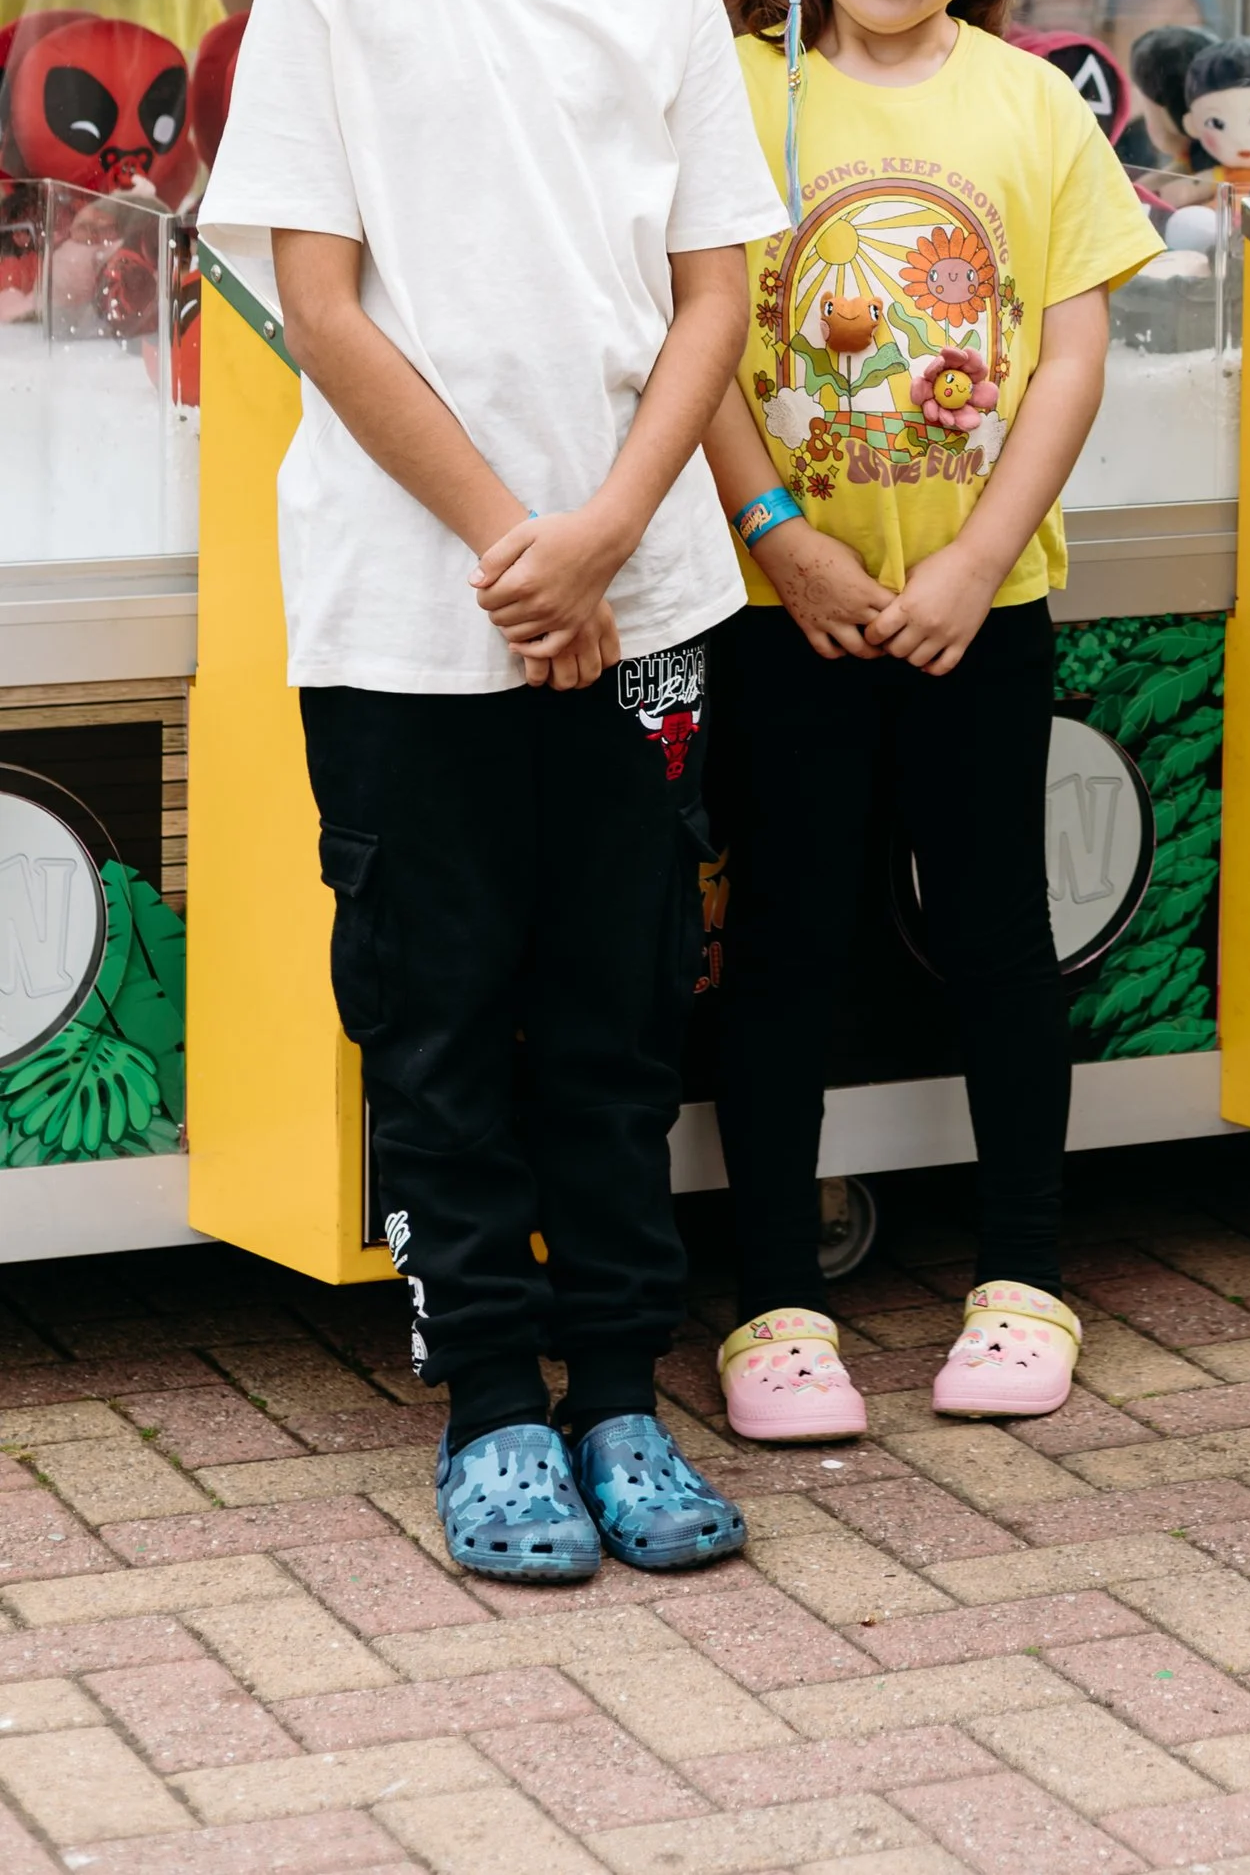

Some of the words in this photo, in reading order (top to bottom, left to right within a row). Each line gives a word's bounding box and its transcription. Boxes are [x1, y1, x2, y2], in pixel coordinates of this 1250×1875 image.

[801, 160, 876, 202] GOING,
[881, 157, 942, 178] KEEP
[946, 171, 1010, 266] GROWING
[844, 438, 922, 488] HAVE
[926, 444, 985, 486] FUN!
